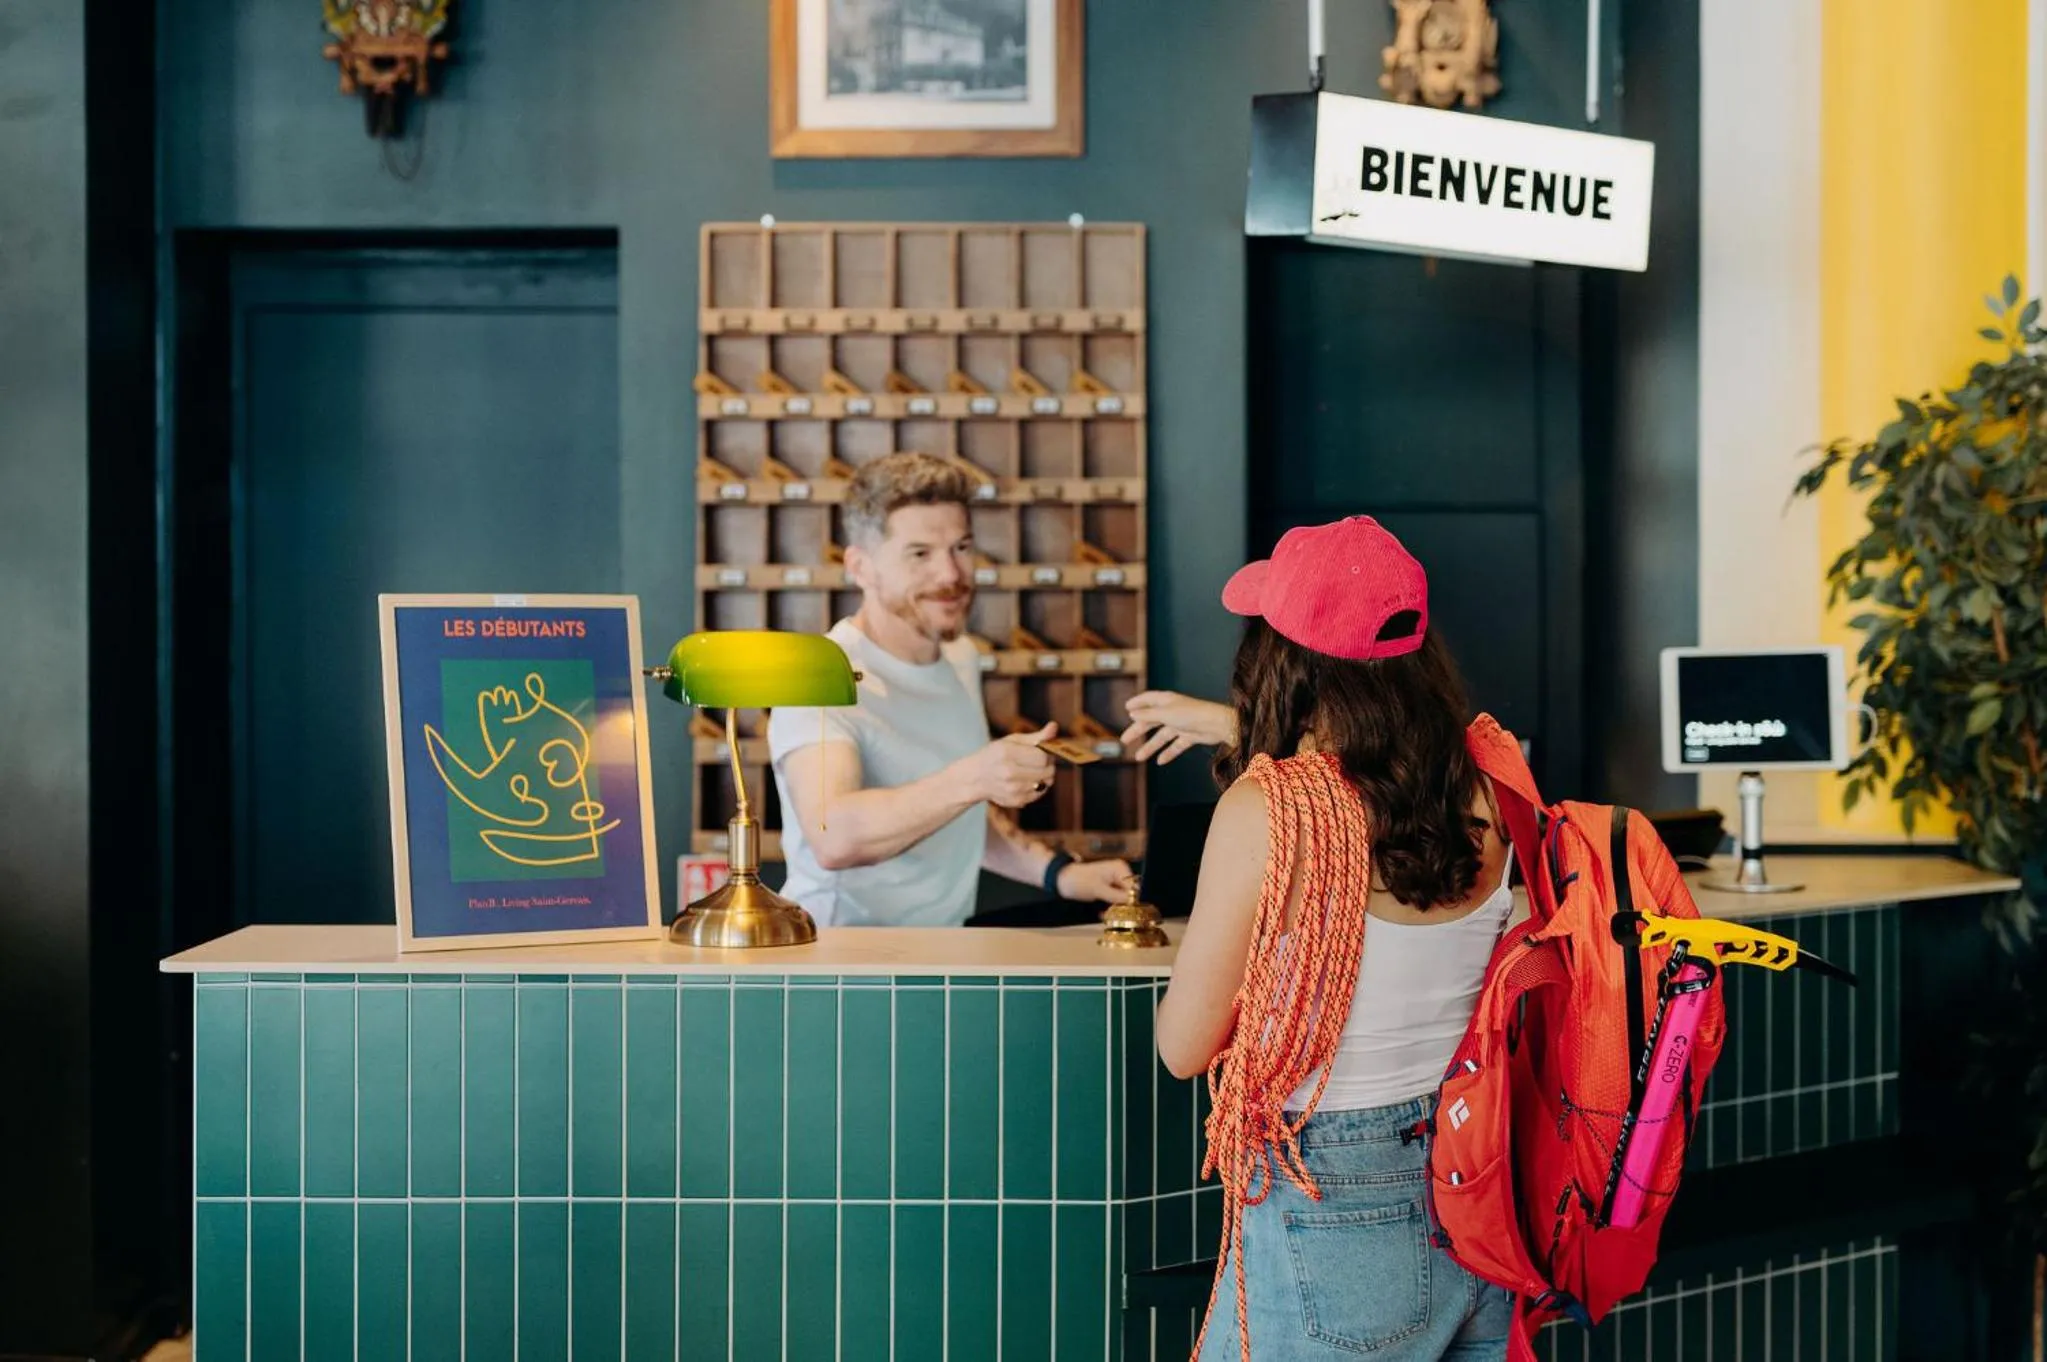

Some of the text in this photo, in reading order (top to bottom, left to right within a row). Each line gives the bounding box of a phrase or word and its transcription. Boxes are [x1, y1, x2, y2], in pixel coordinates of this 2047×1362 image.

[1360, 145, 1614, 221] BIENVENUE
[443, 616, 587, 638] LES DÉBUTANTS
